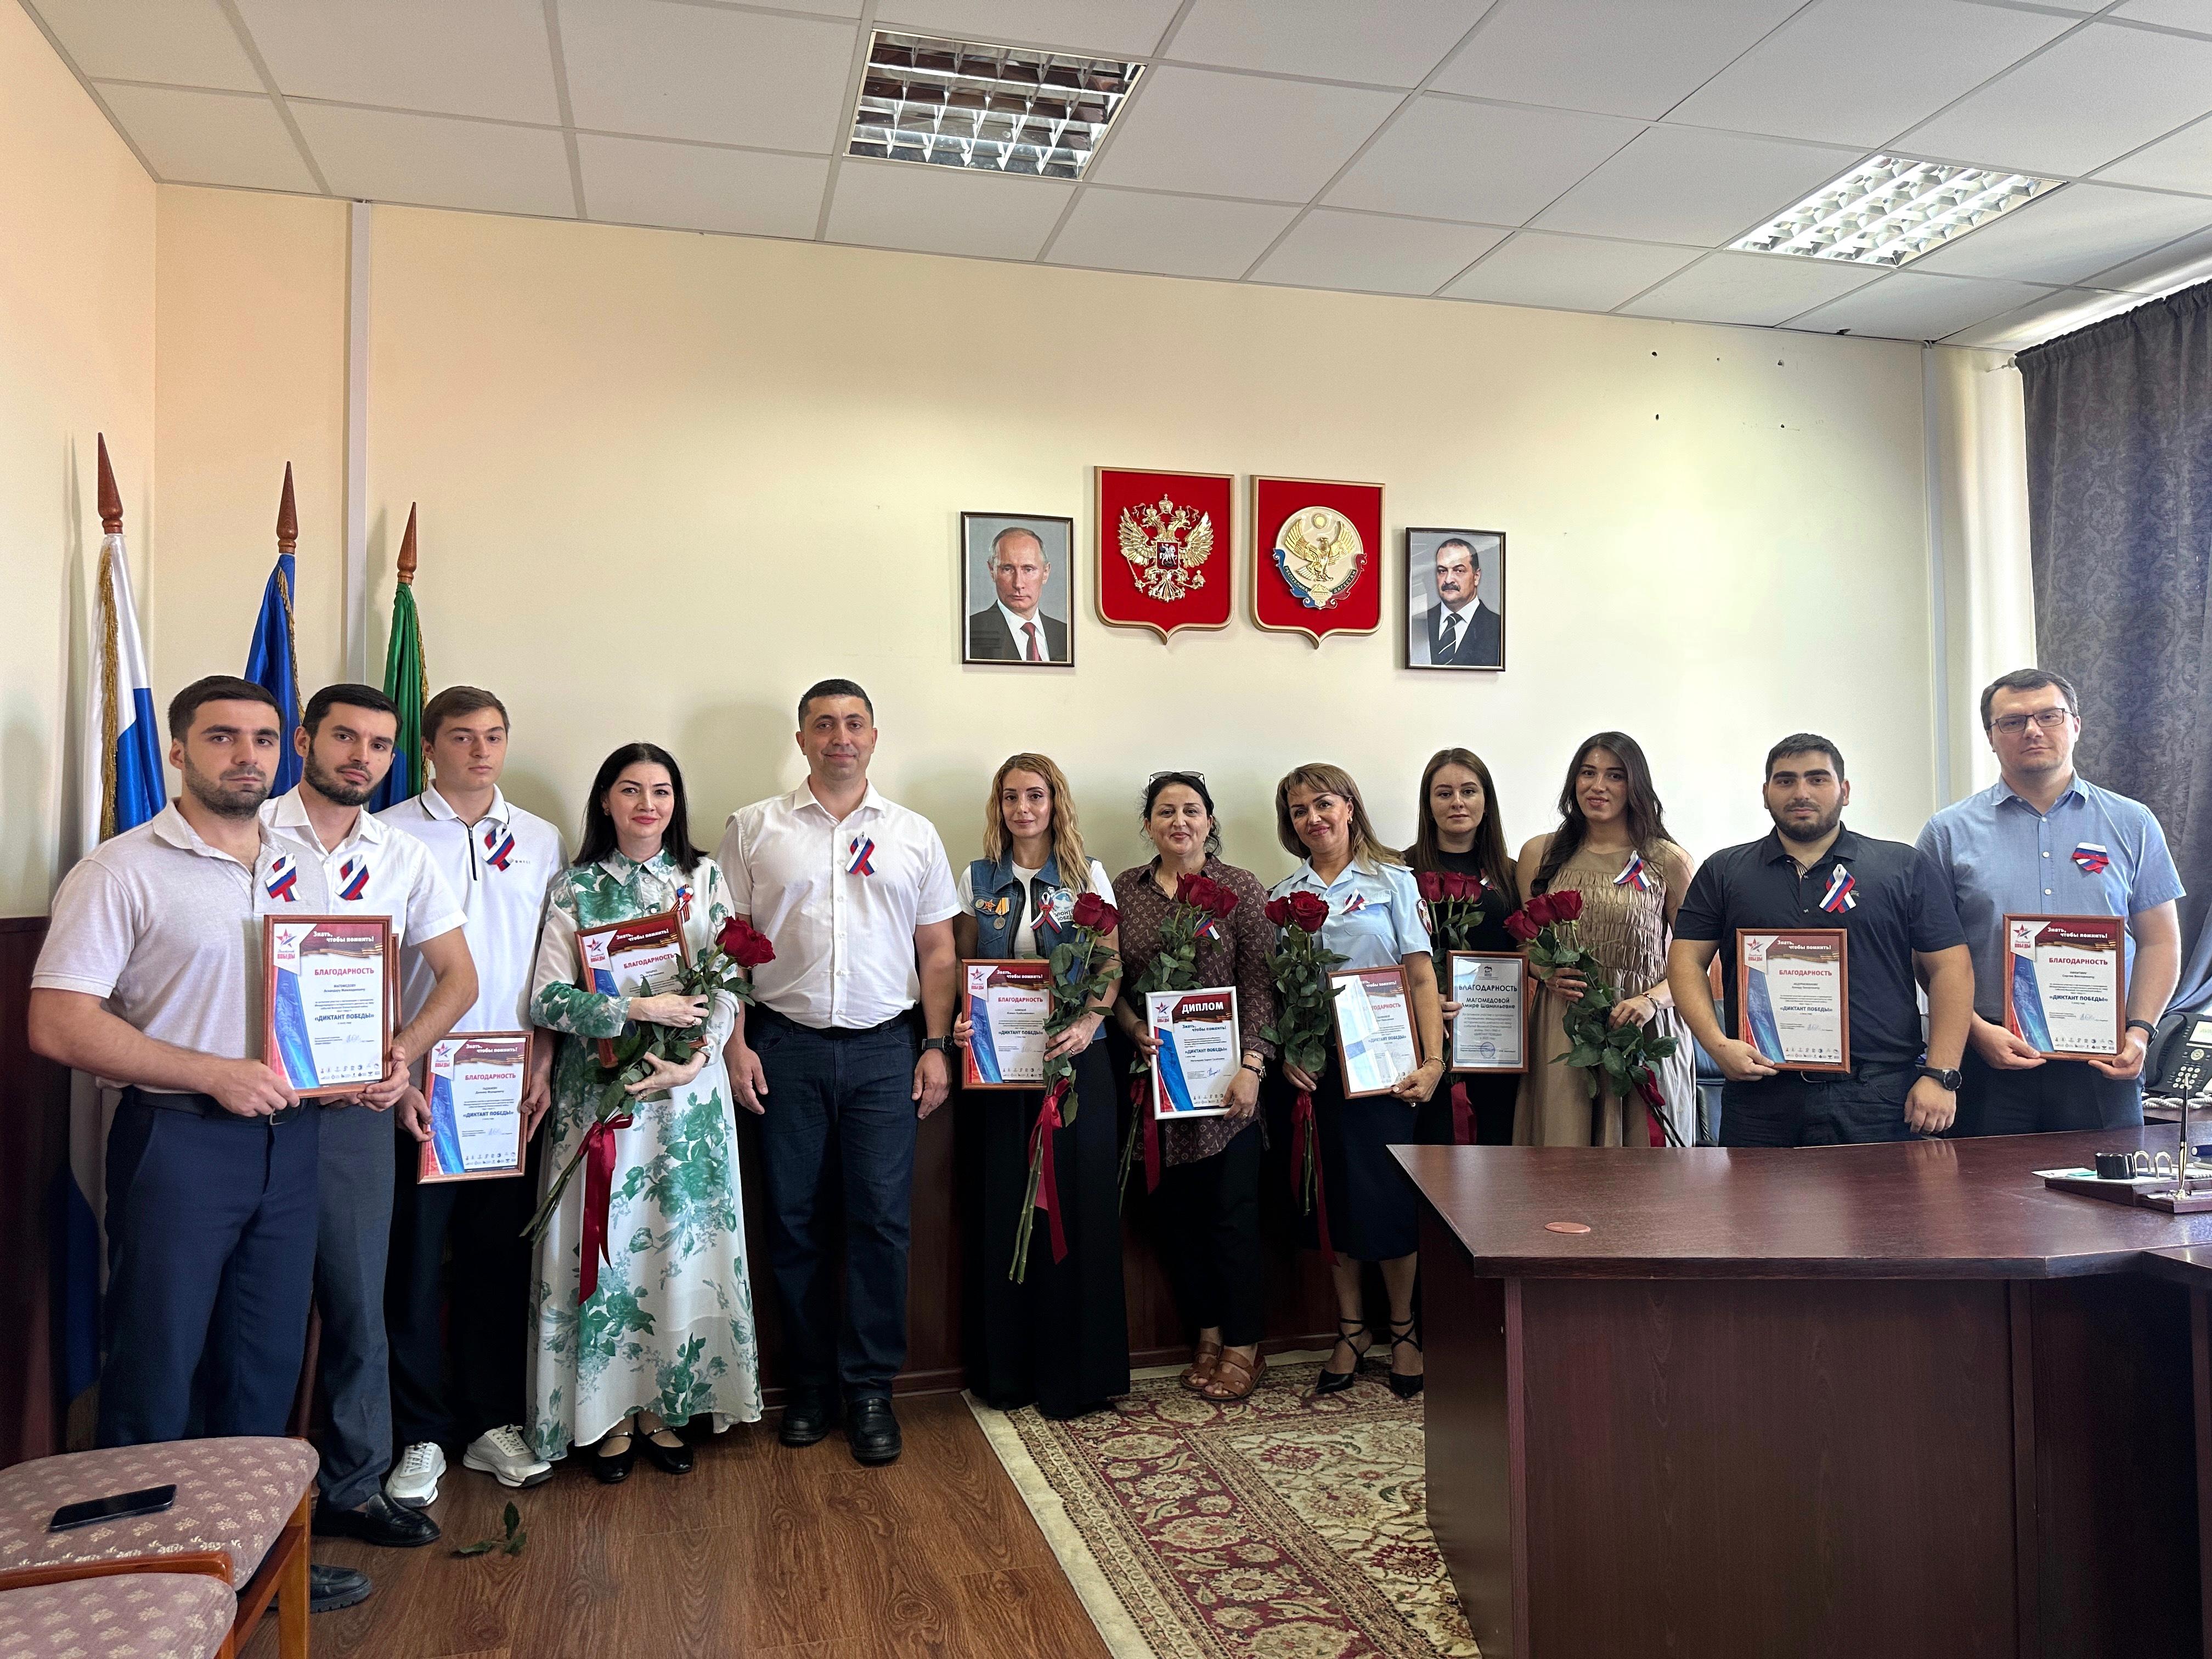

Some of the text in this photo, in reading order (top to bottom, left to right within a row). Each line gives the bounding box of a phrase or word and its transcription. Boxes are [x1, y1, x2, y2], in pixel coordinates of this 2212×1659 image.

[1284, 566, 1356, 594] РЕСПУБЛИКА ДАГЕСТАН
[623, 953, 675, 969] БЛАГОДАРНОСТЬ
[314, 968, 375, 976] БЛАГОДАРНОСТЬ
[1182, 1002, 1224, 1014] ДИПЛОМ
